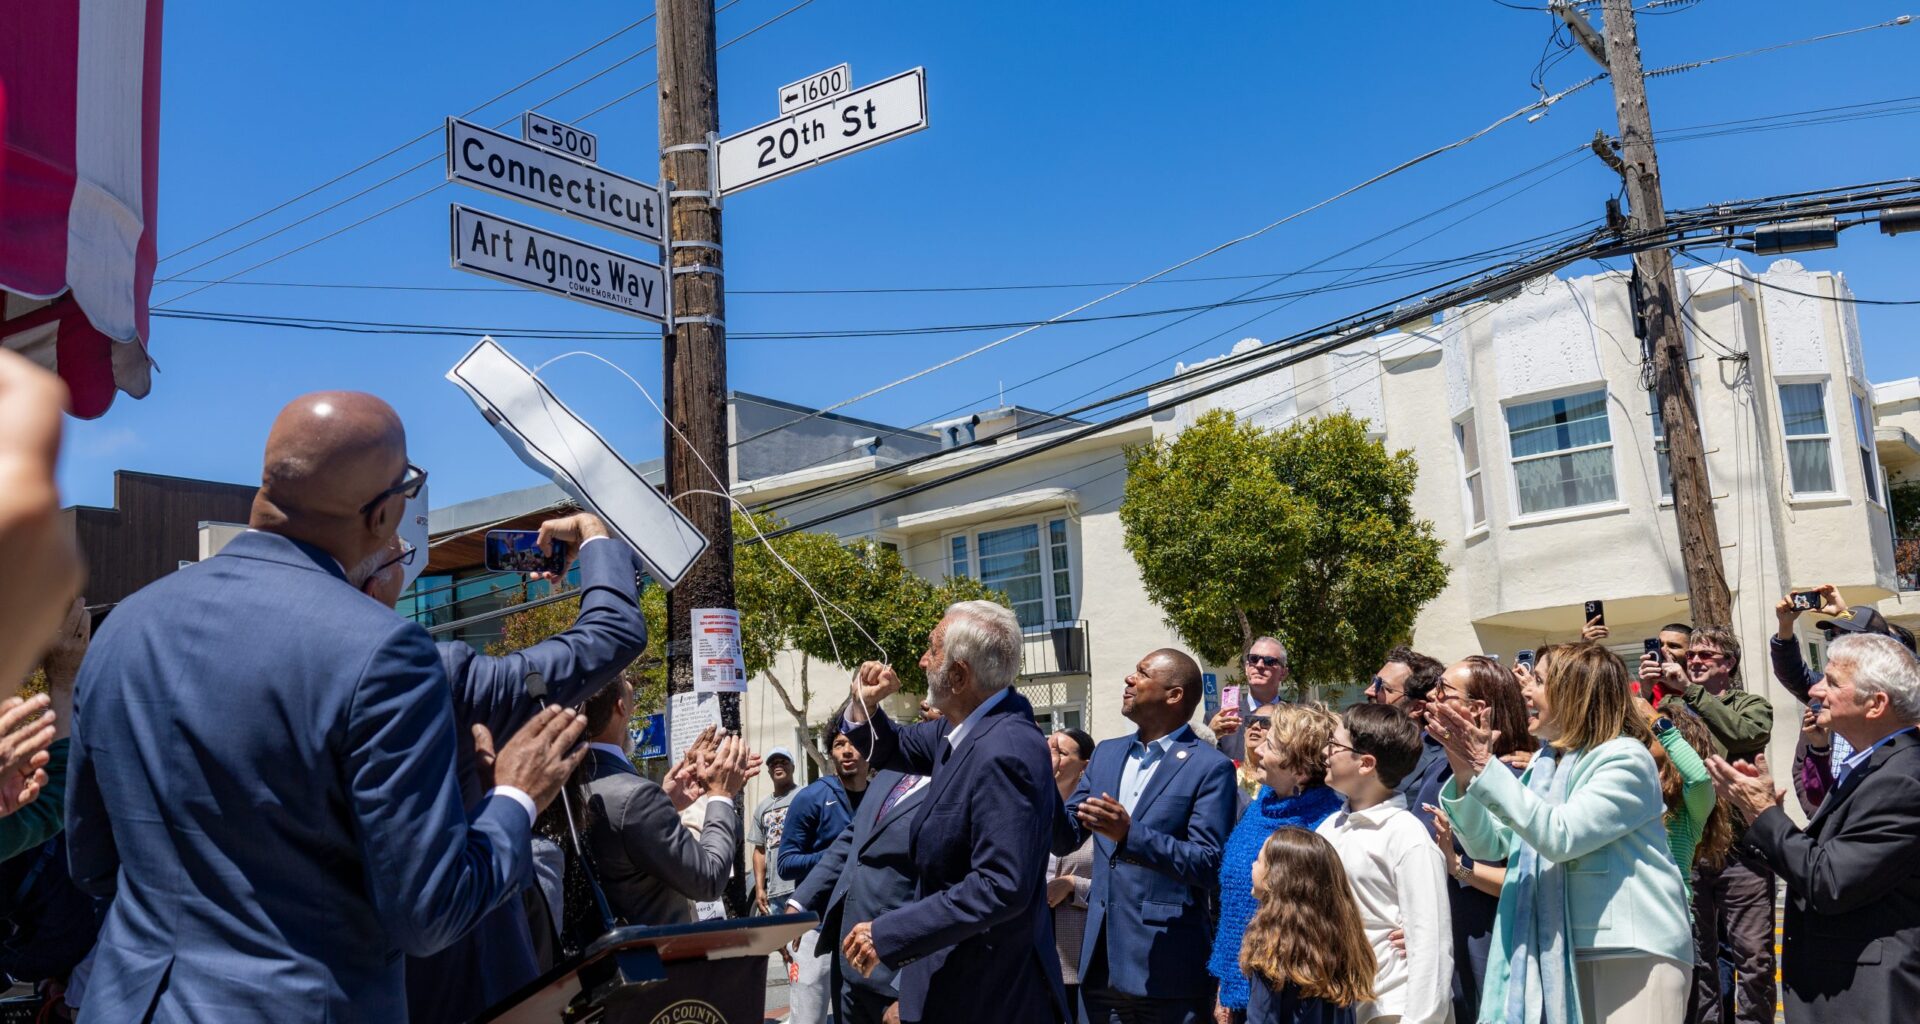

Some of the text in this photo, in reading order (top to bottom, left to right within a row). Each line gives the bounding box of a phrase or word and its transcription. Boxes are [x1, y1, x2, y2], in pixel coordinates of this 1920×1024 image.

[802, 71, 841, 103] 1600
[552, 124, 591, 157] 500
[757, 99, 877, 169] 20th St
[462, 137, 655, 228] Connecticut
[471, 221, 655, 308] Art Agnos Way
[568, 280, 634, 306] COMMEMORATIVE
[672, 1005, 719, 1024] COUNTY
